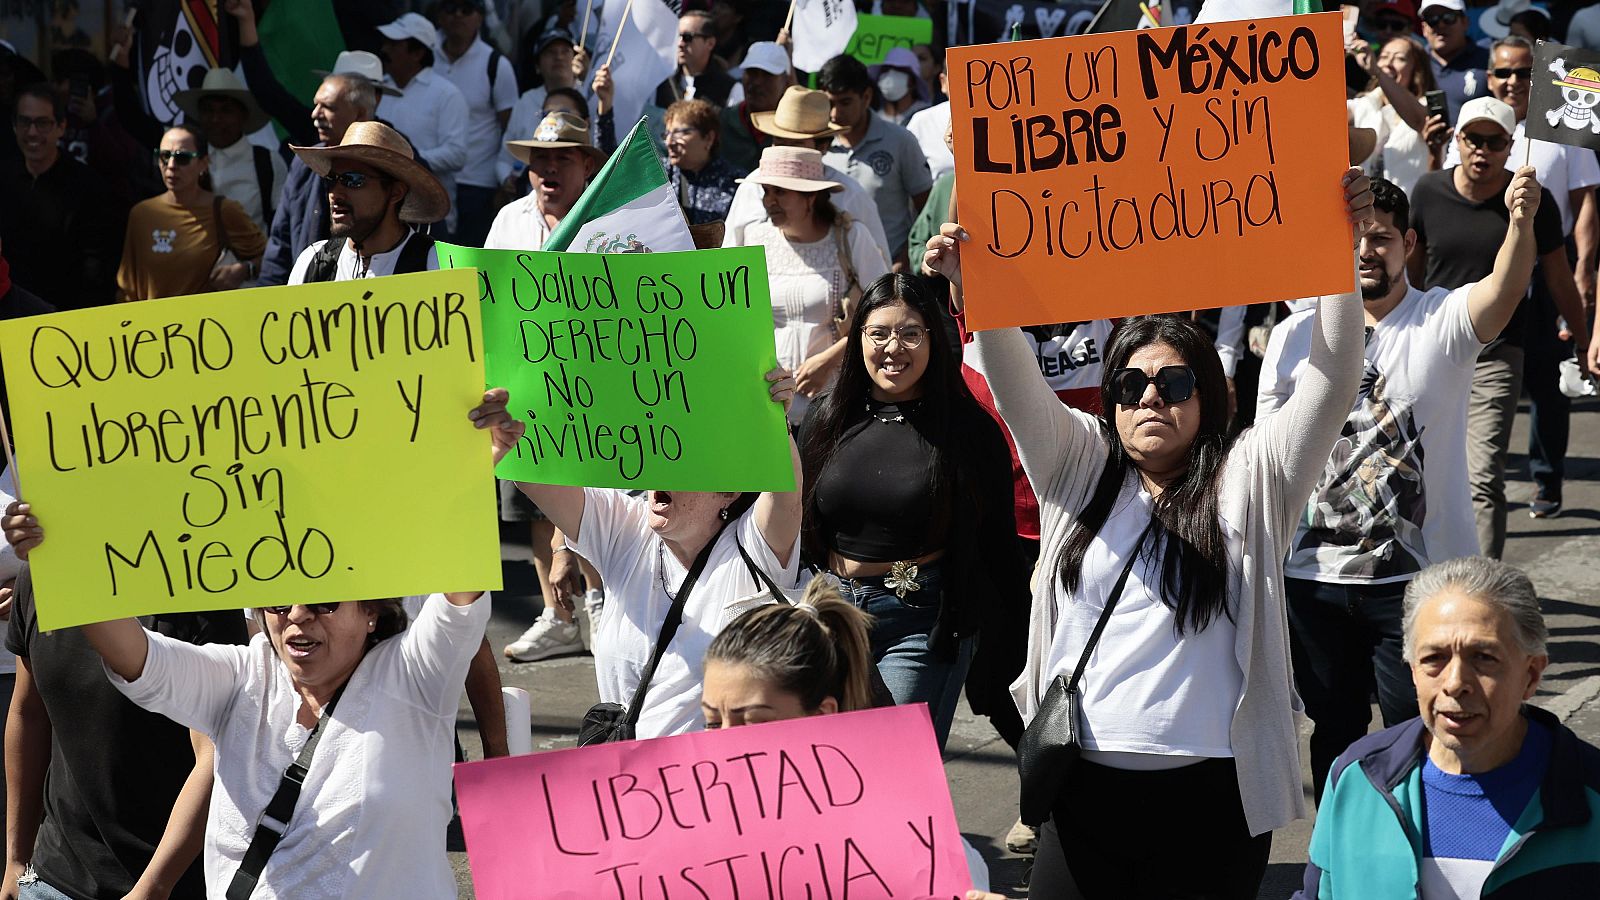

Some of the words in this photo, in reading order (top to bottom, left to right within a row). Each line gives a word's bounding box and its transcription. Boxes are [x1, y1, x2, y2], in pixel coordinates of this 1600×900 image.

[967, 57, 1036, 111] POR
[1136, 22, 1320, 101] México
[512, 252, 619, 312] Salud
[637, 273, 684, 314] es
[701, 266, 752, 310] un
[519, 314, 697, 367] DERECHO
[543, 362, 595, 409] No
[104, 510, 355, 598] Miedo.
[540, 743, 865, 856] LIBERTAD
